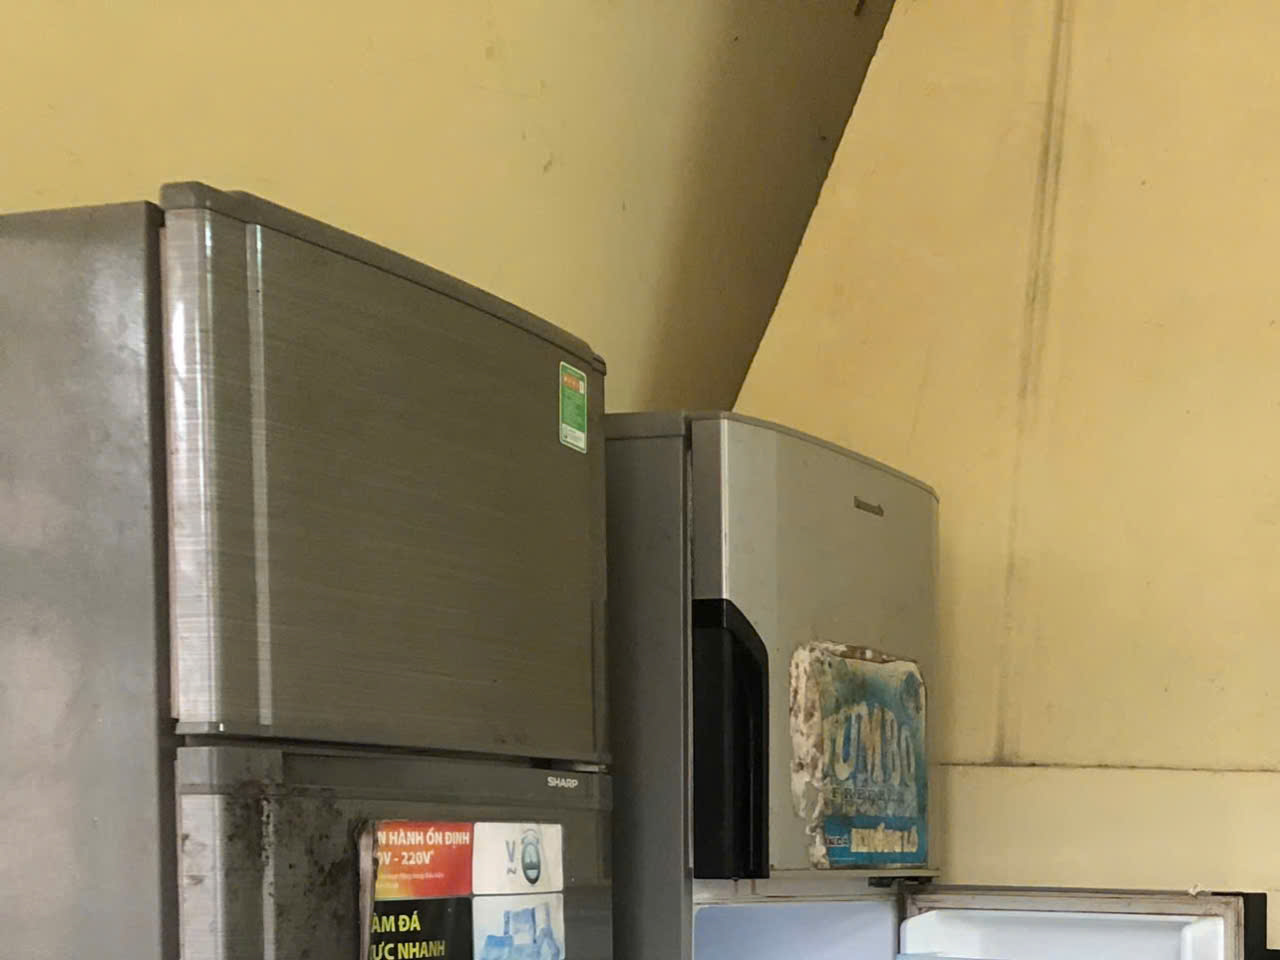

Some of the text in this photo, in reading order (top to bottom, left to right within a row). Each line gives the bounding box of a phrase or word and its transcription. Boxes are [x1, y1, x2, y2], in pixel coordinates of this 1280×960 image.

[547, 776, 578, 788] SHARP
[389, 828, 424, 846] HÀNH
[445, 831, 470, 849] ĐỊNH
[398, 910, 421, 932] ĐÁ
[397, 940, 446, 960] NHANH
